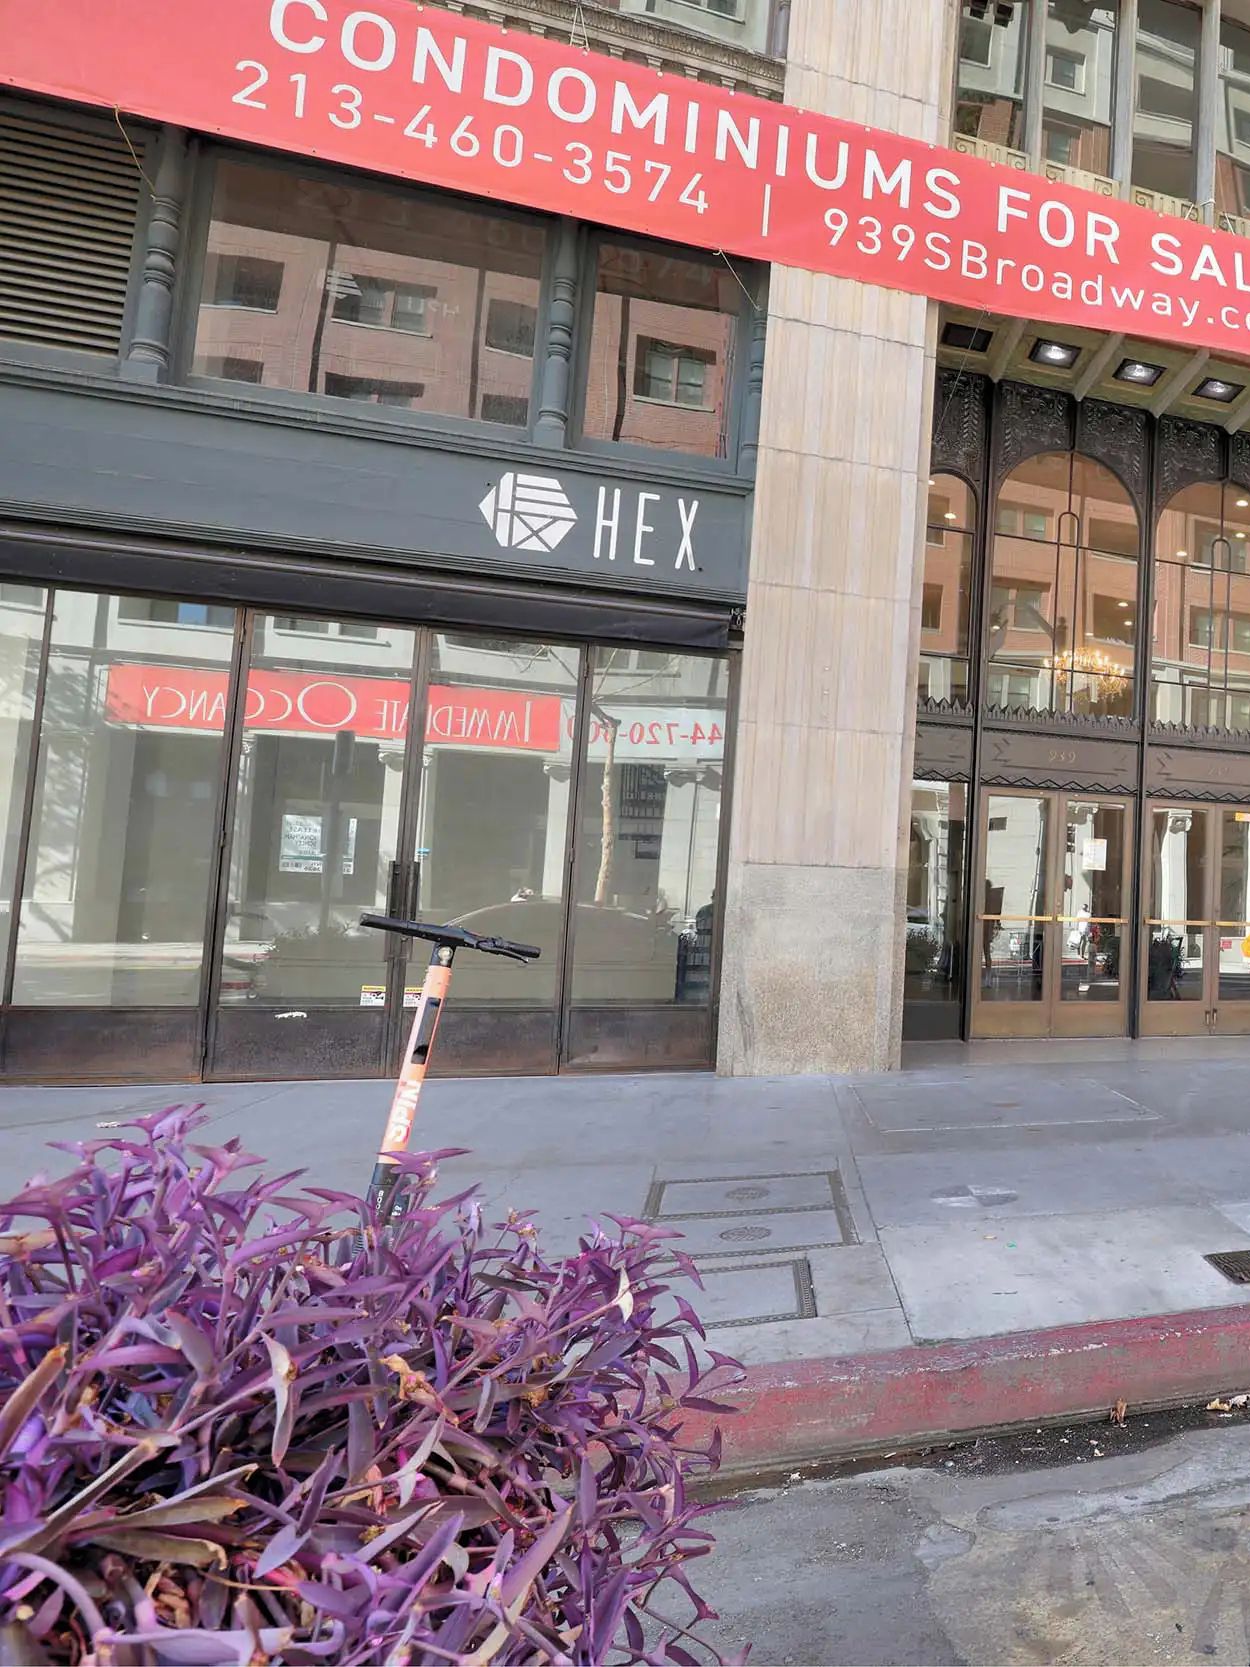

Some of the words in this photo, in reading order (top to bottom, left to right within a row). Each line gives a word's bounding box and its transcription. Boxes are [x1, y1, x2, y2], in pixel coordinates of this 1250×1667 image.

[231, 60, 709, 214] 213-460-3574
[269, 0, 961, 219] CONDOMINIUMS
[997, 185, 1120, 265] FOR
[593, 486, 699, 571] HEX
